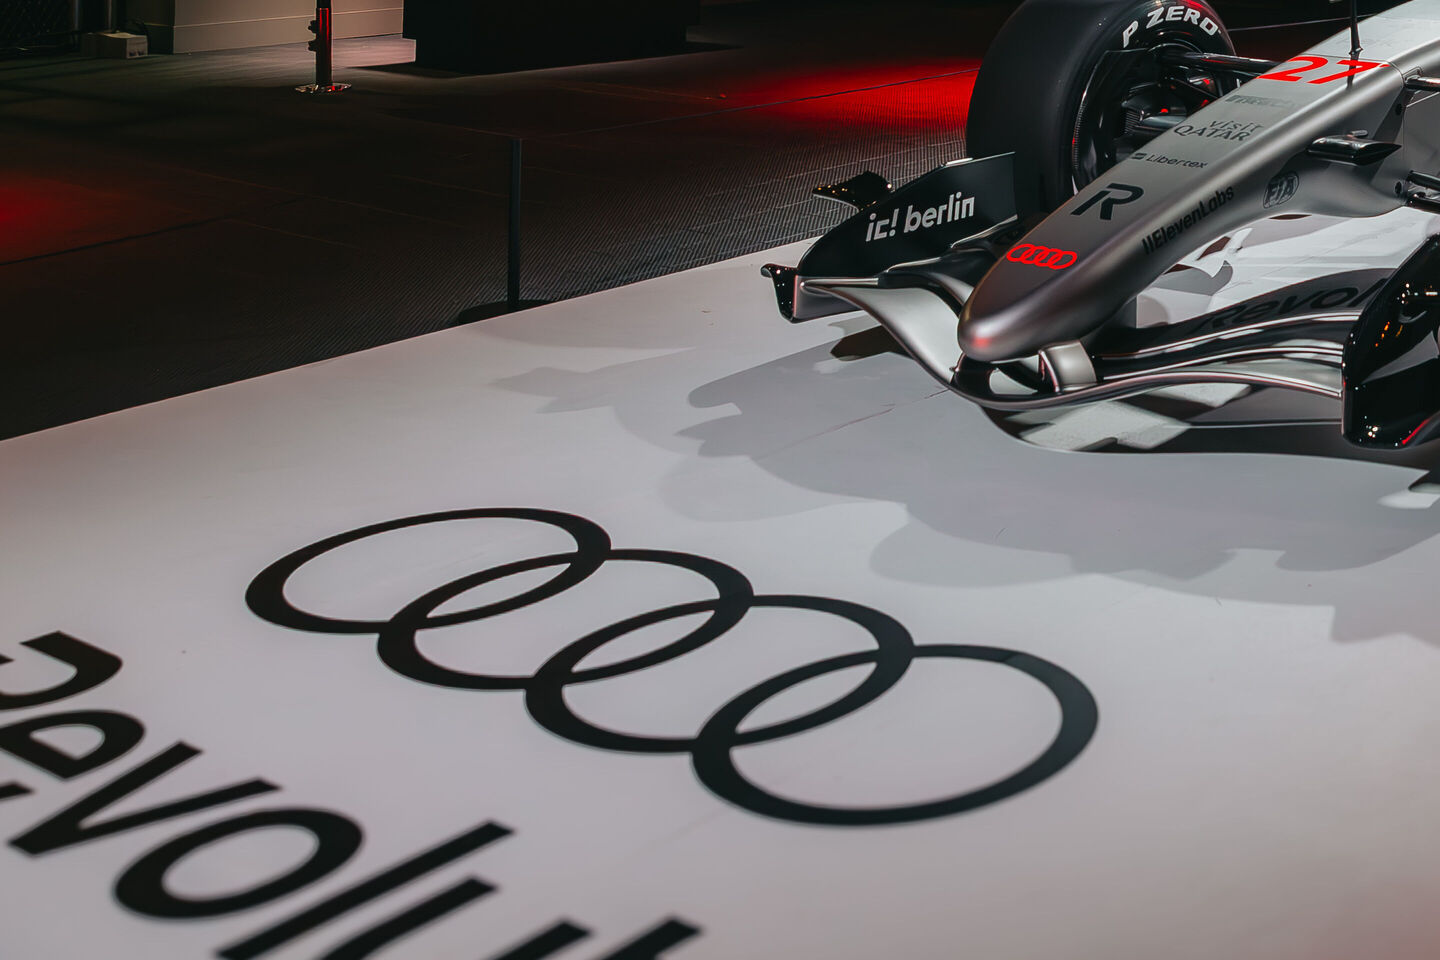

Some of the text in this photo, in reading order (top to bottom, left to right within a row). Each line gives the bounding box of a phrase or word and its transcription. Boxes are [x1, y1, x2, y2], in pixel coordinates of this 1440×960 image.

[1122, 5, 1219, 48] P ZERO
[1257, 56, 1389, 84] 27
[1174, 124, 1251, 142] QATAR
[1146, 153, 1209, 169] Libertex
[903, 191, 976, 234] berlin
